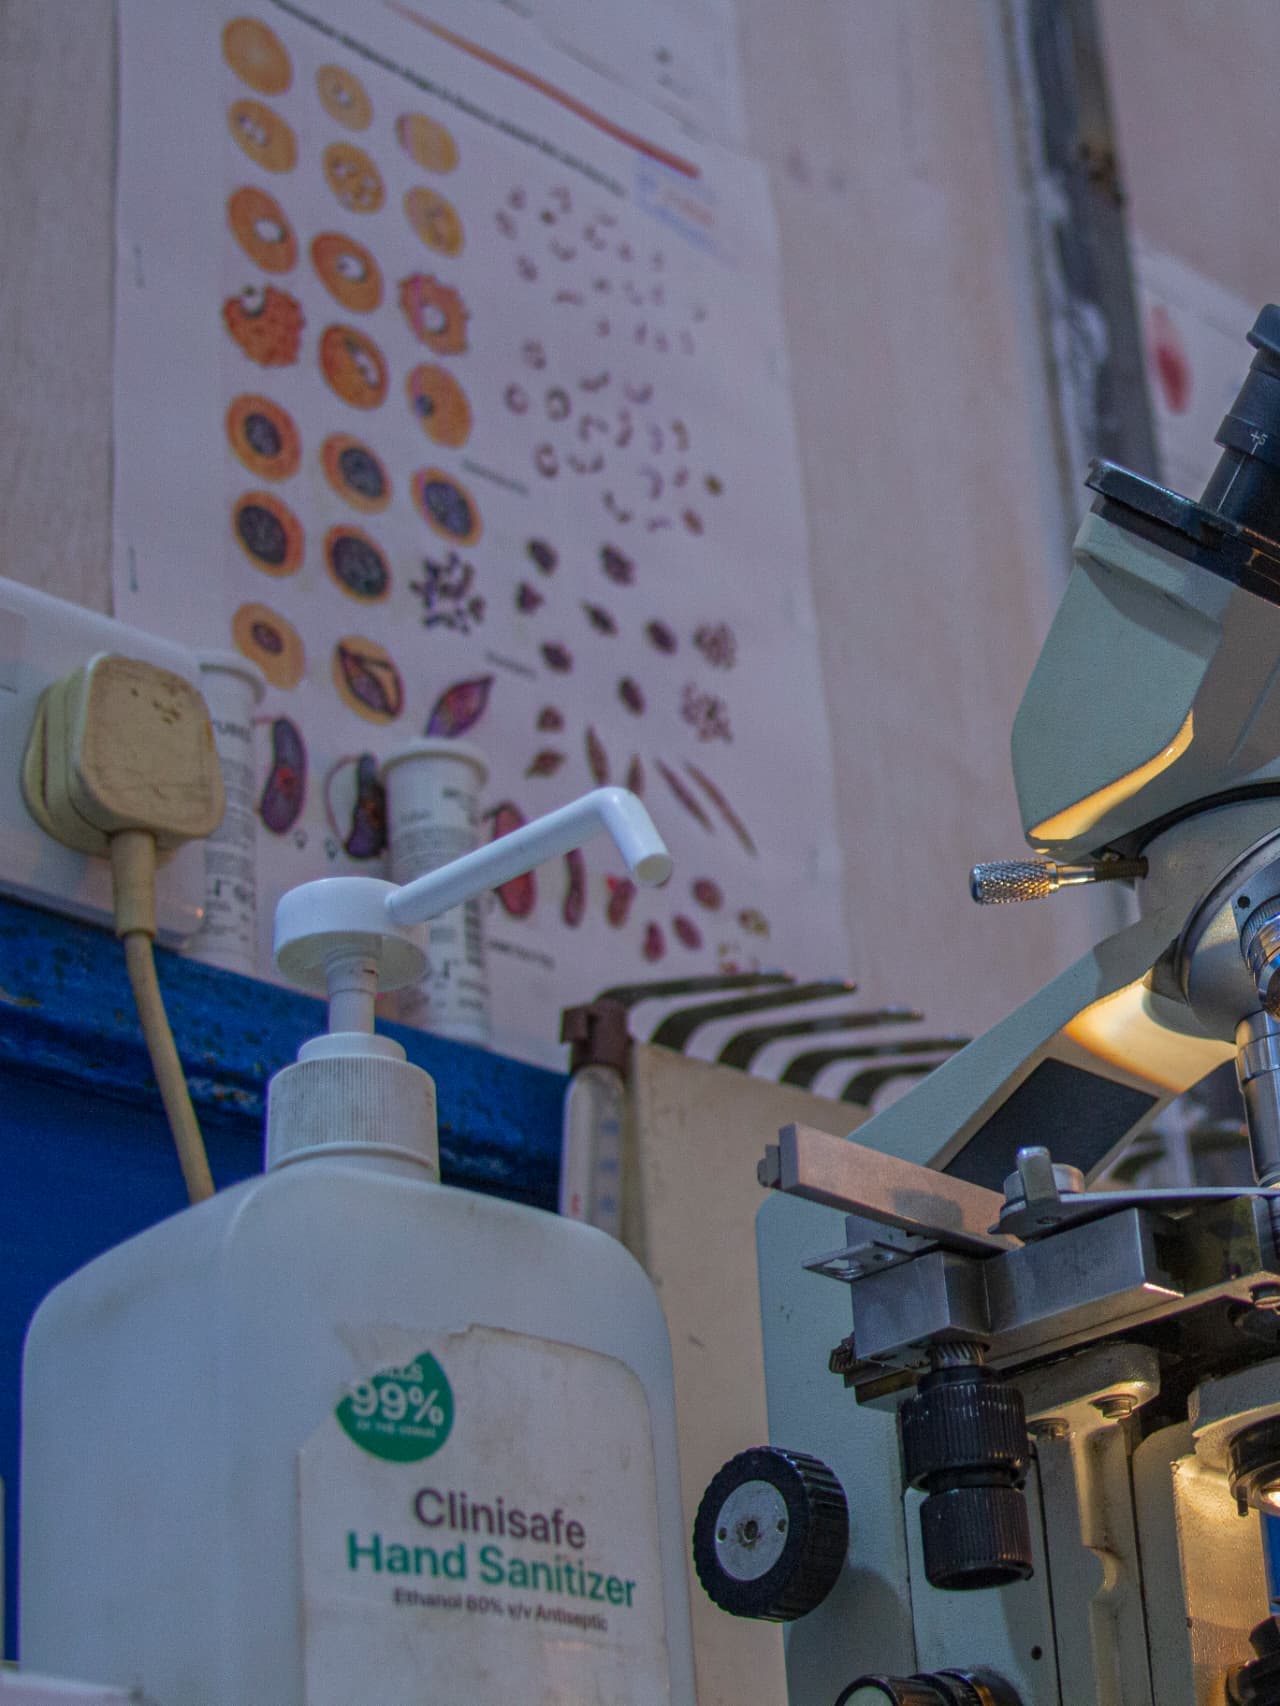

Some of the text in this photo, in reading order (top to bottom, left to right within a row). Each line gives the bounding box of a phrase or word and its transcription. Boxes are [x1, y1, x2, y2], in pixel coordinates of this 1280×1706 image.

[1250, 431, 1268, 445] +5
[352, 1380, 445, 1427] 99%
[414, 1487, 586, 1549] Clinisafe
[346, 1529, 636, 1608] Hand Sanitizer
[393, 1586, 462, 1609] Ethanol
[535, 1603, 608, 1632] Antiseptic
